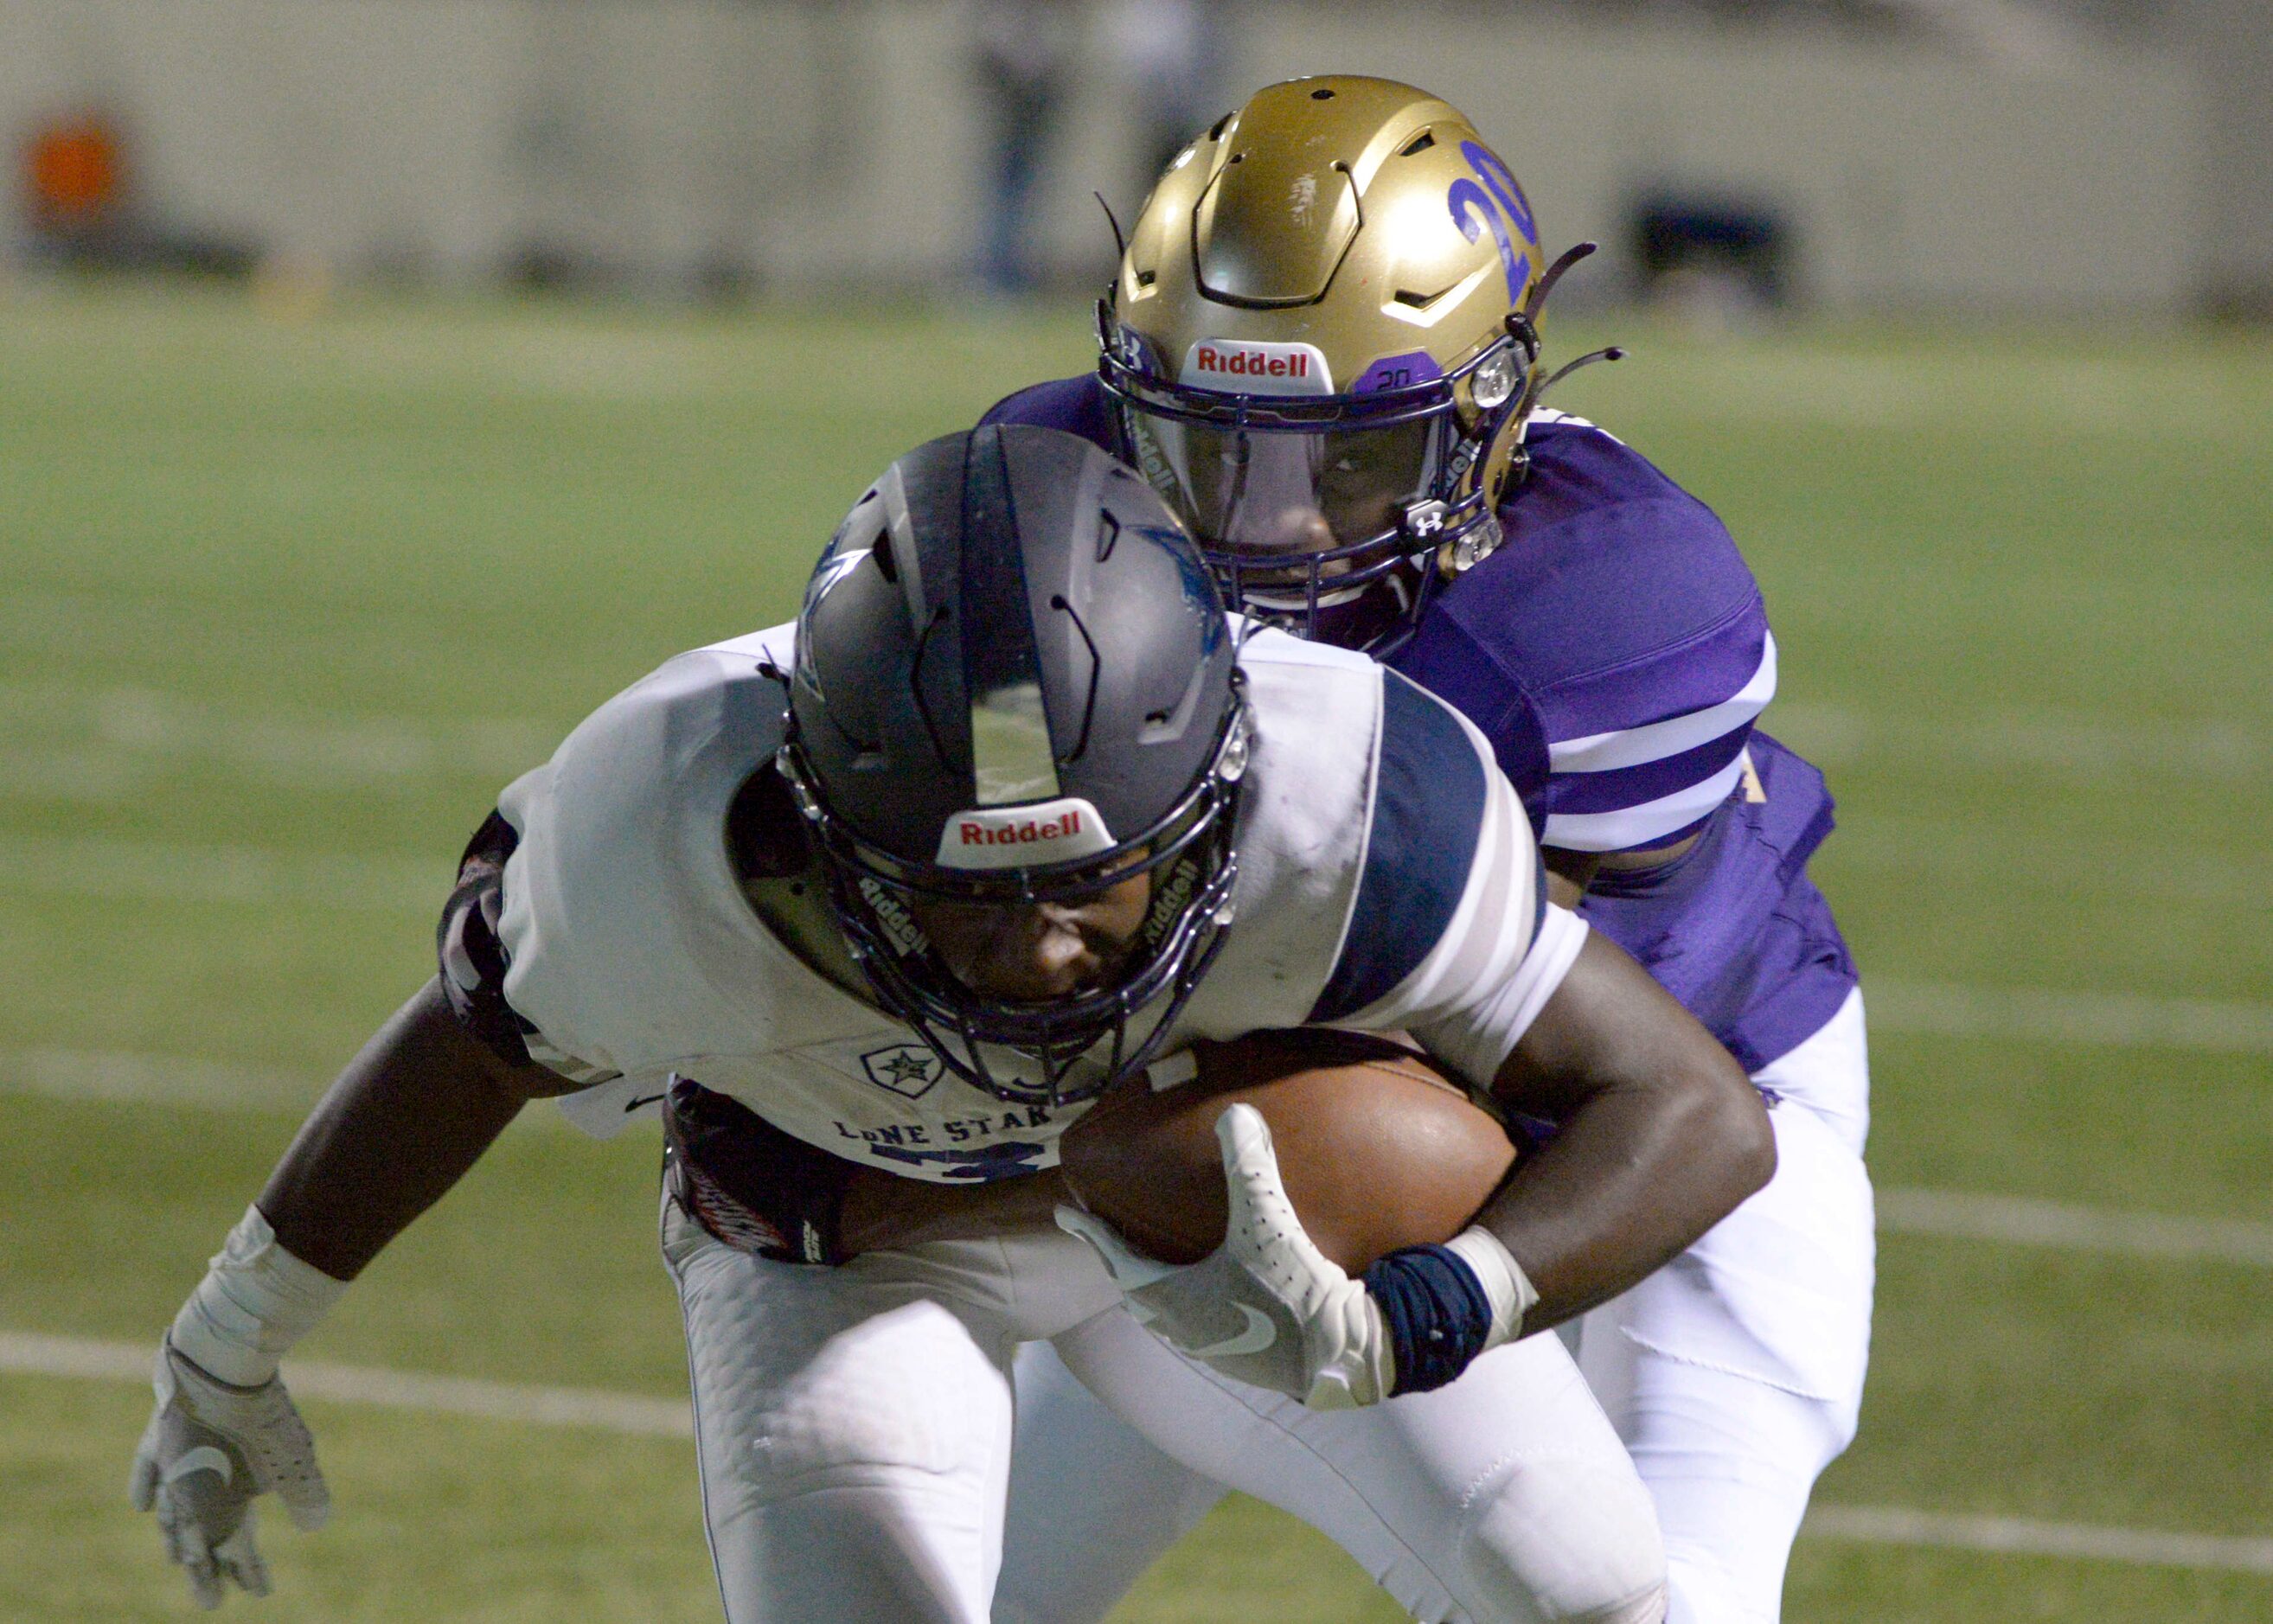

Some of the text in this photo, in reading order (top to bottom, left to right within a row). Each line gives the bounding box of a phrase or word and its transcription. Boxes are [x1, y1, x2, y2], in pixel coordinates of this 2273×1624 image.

[1197, 346, 1309, 379] Riddell
[960, 810, 1081, 847] Riddell
[944, 1105, 1052, 1142] STAR
